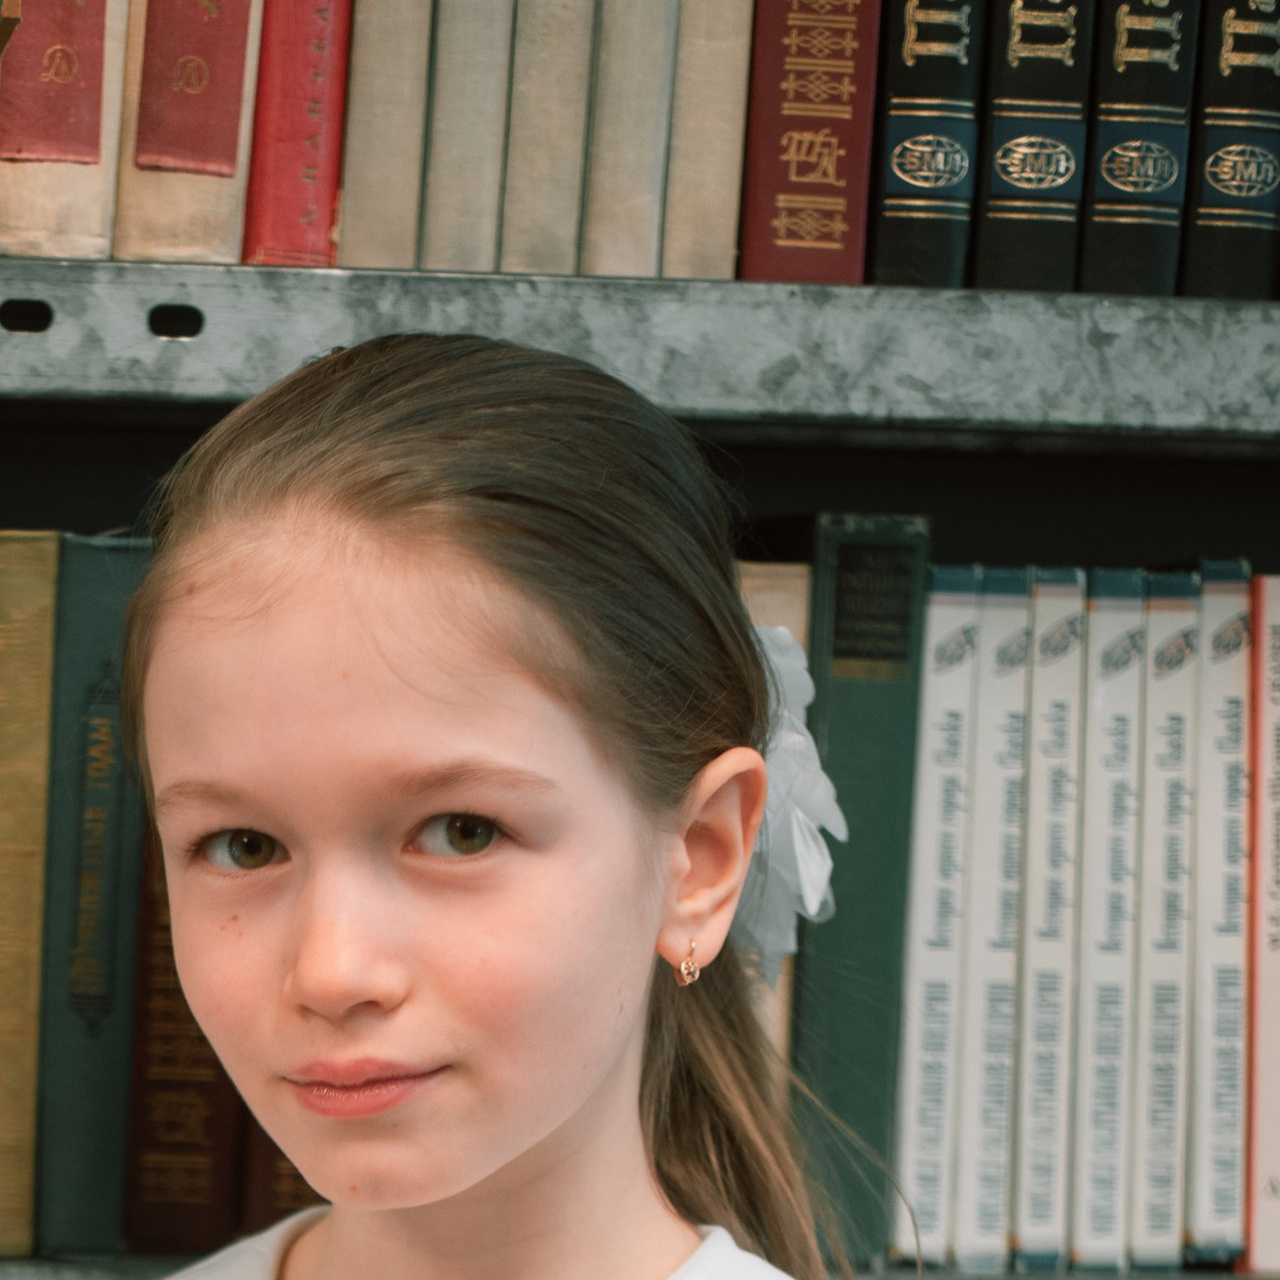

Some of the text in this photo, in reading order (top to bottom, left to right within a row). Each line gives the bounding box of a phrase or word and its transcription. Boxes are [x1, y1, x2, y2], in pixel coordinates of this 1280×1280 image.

[903, 149, 962, 175] БМЛ
[1007, 149, 1068, 175] БМЛ
[1113, 151, 1169, 178] БМЛ
[1217, 155, 1278, 183] БМЛ
